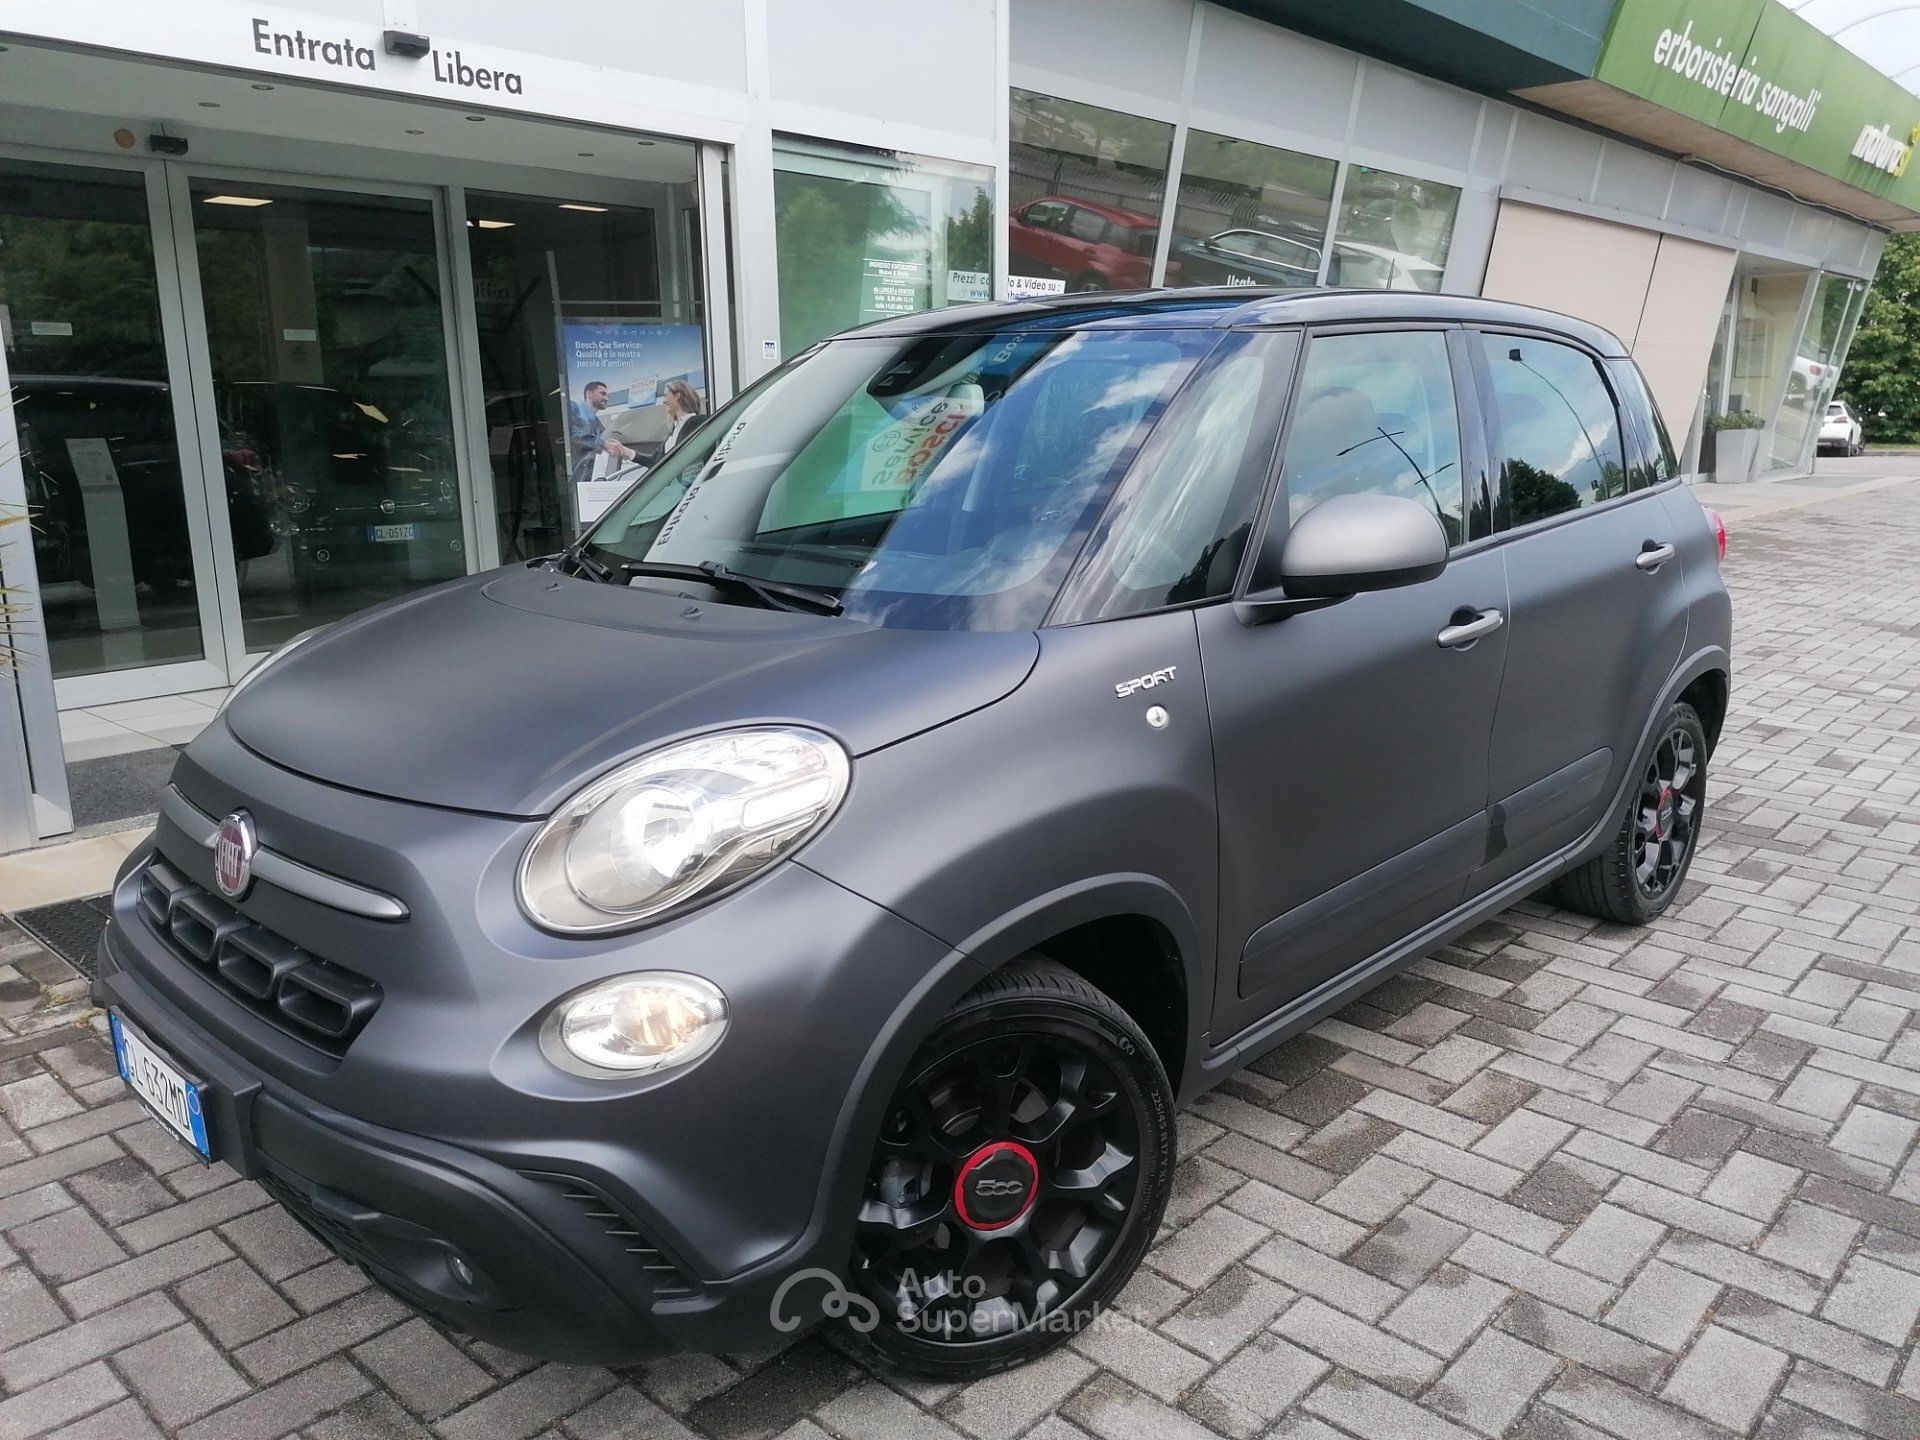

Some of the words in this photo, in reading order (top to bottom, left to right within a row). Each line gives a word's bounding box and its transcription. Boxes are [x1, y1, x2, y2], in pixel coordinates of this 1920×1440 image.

[252, 18, 376, 71] Entrata
[432, 50, 522, 95] Libera
[1653, 20, 1760, 106] erboristeria
[1755, 81, 1822, 134] sangalli
[953, 272, 976, 285] Prezzi
[1024, 280, 1046, 291] Video
[575, 341, 598, 349] Bosch
[598, 341, 612, 349] Car
[613, 341, 643, 349] Service:
[576, 350, 602, 358] Qualità
[603, 350, 609, 358] è
[609, 350, 617, 358] la
[617, 350, 641, 358] nostra
[576, 360, 600, 368] parola
[1115, 666, 1177, 698] SPORT
[219, 836, 242, 879] FIAT
[975, 1179, 1024, 1196] 500
